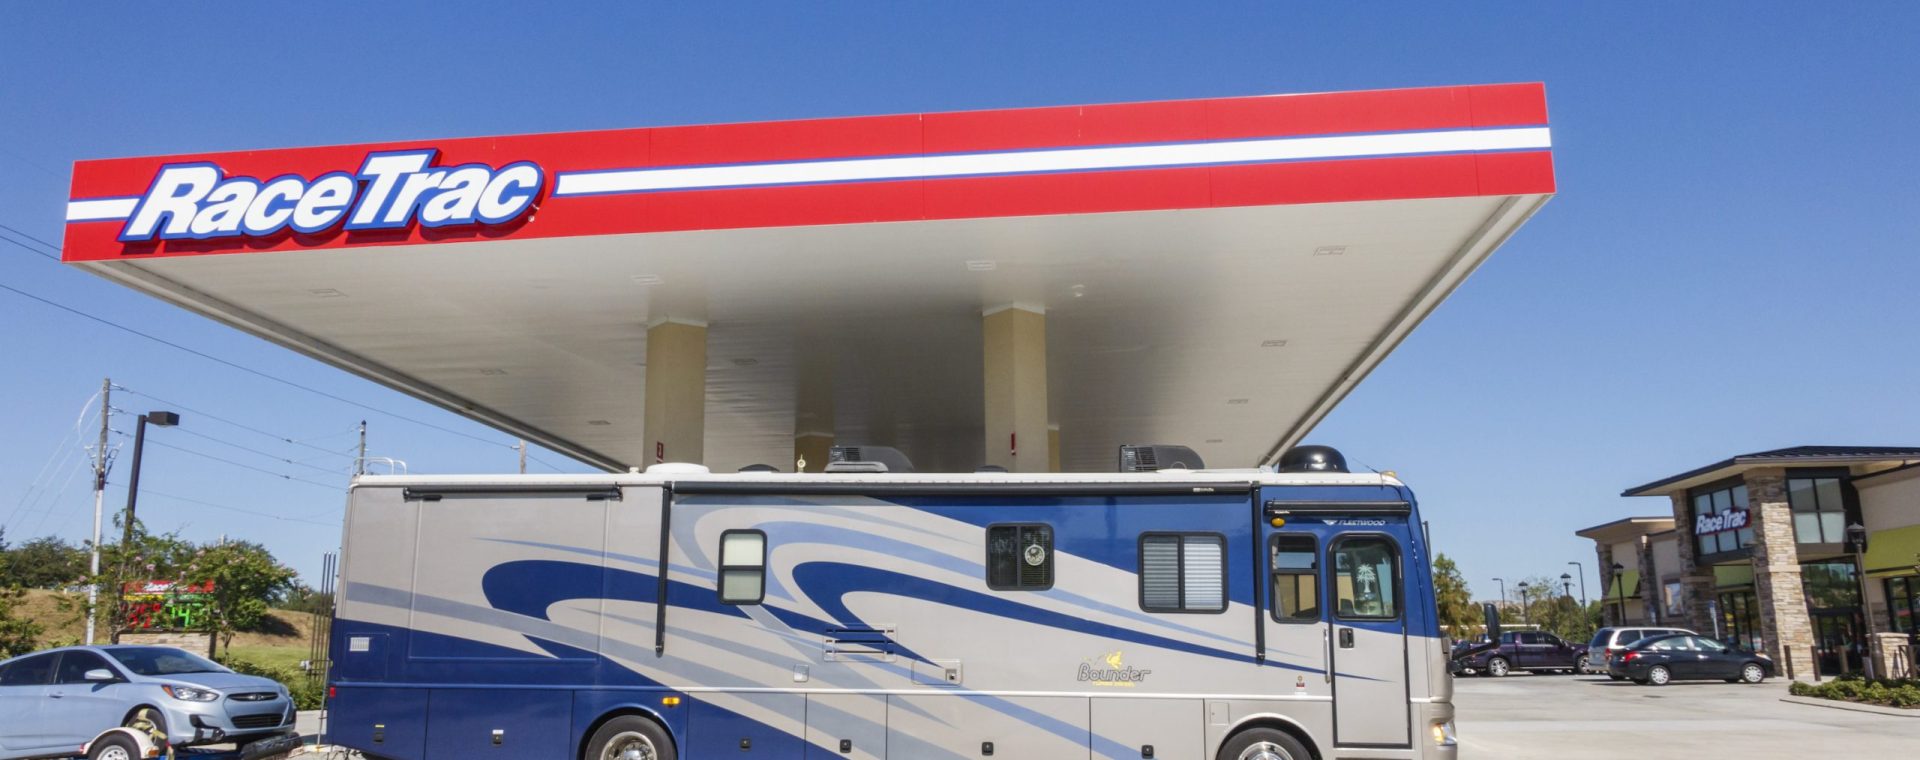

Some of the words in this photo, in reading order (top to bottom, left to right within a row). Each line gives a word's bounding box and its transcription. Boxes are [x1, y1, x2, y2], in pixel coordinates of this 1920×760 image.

[119, 149, 543, 241] RaceTrac
[1695, 508, 1747, 535] RaceTrac
[1077, 662, 1152, 682] Bounder
